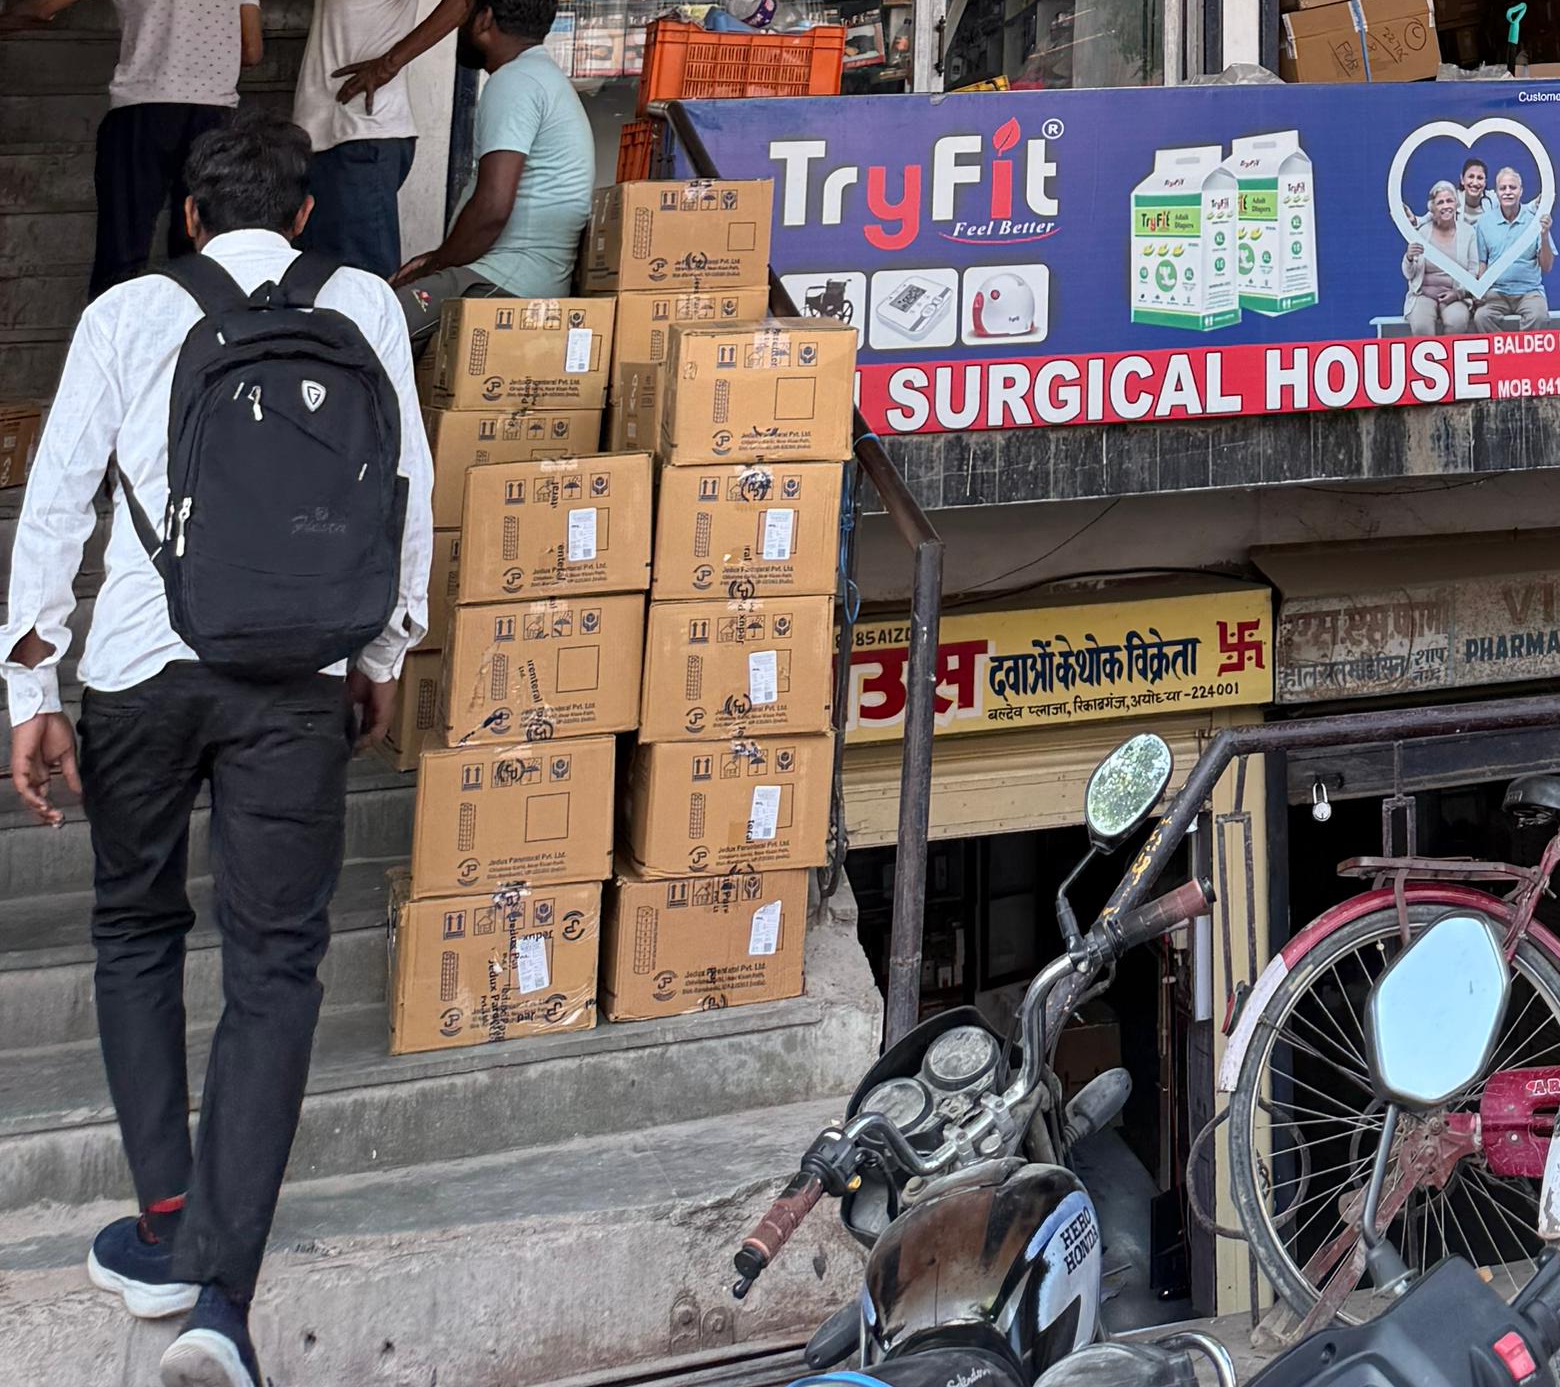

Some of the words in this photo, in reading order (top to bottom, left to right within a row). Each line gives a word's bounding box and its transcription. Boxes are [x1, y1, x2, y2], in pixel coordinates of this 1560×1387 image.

[769, 116, 1060, 251] TryFit
[952, 220, 993, 238] Feel
[998, 218, 1056, 236] Better
[1141, 210, 1171, 232] TryFit
[1494, 333, 1556, 355] BALDEO
[885, 351, 1243, 432] SURGICAL
[1264, 338, 1492, 413] HOUSE
[1498, 378, 1537, 399] MOB.
[1125, 627, 1202, 686] विक्रेता
[1060, 1206, 1092, 1251] HERO
[1063, 1230, 1100, 1276] HONDA
